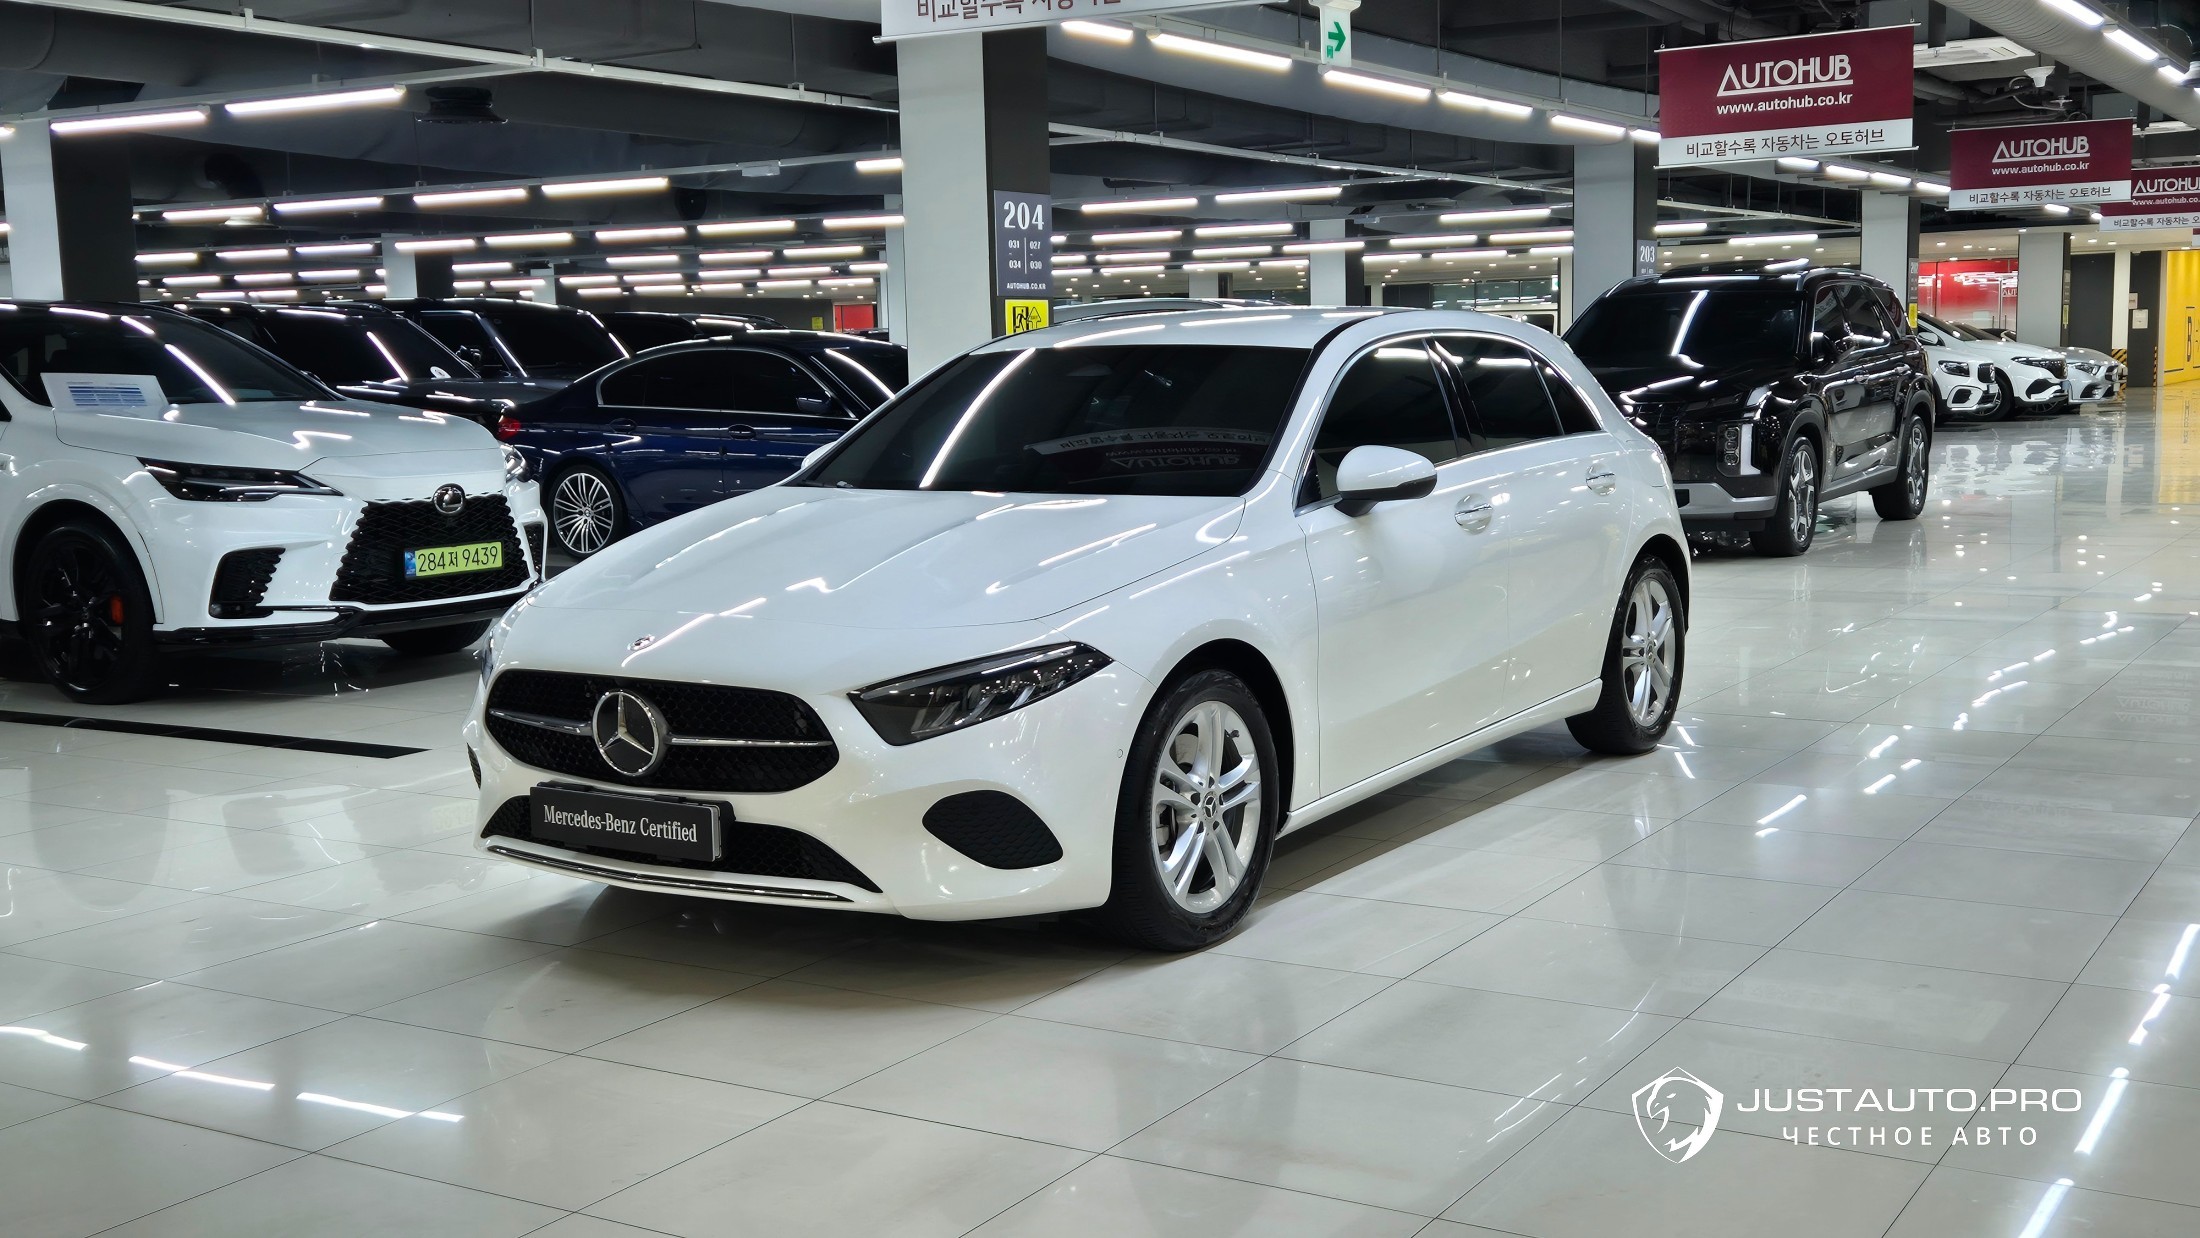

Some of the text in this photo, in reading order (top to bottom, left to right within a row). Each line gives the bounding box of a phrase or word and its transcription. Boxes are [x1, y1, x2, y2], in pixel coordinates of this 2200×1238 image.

[1717, 54, 1853, 97] AUTOHUB
[1717, 92, 1853, 115] www.autohub.co.kr
[1686, 128, 1885, 158] 비교할수록 자동차는 오토허브
[1992, 135, 2090, 163] AUTOHUB
[1992, 161, 2090, 175] www.autohub.co.kr
[1969, 186, 2112, 204] 비교할수록 자동차는 오토허브
[2132, 177, 2200, 197] AUTOHU
[1004, 201, 1045, 230] 204
[1640, 246, 1655, 262] 203
[418, 545, 498, 573] 284저 9439
[544, 805, 698, 842] Mercedes-Benz Certified
